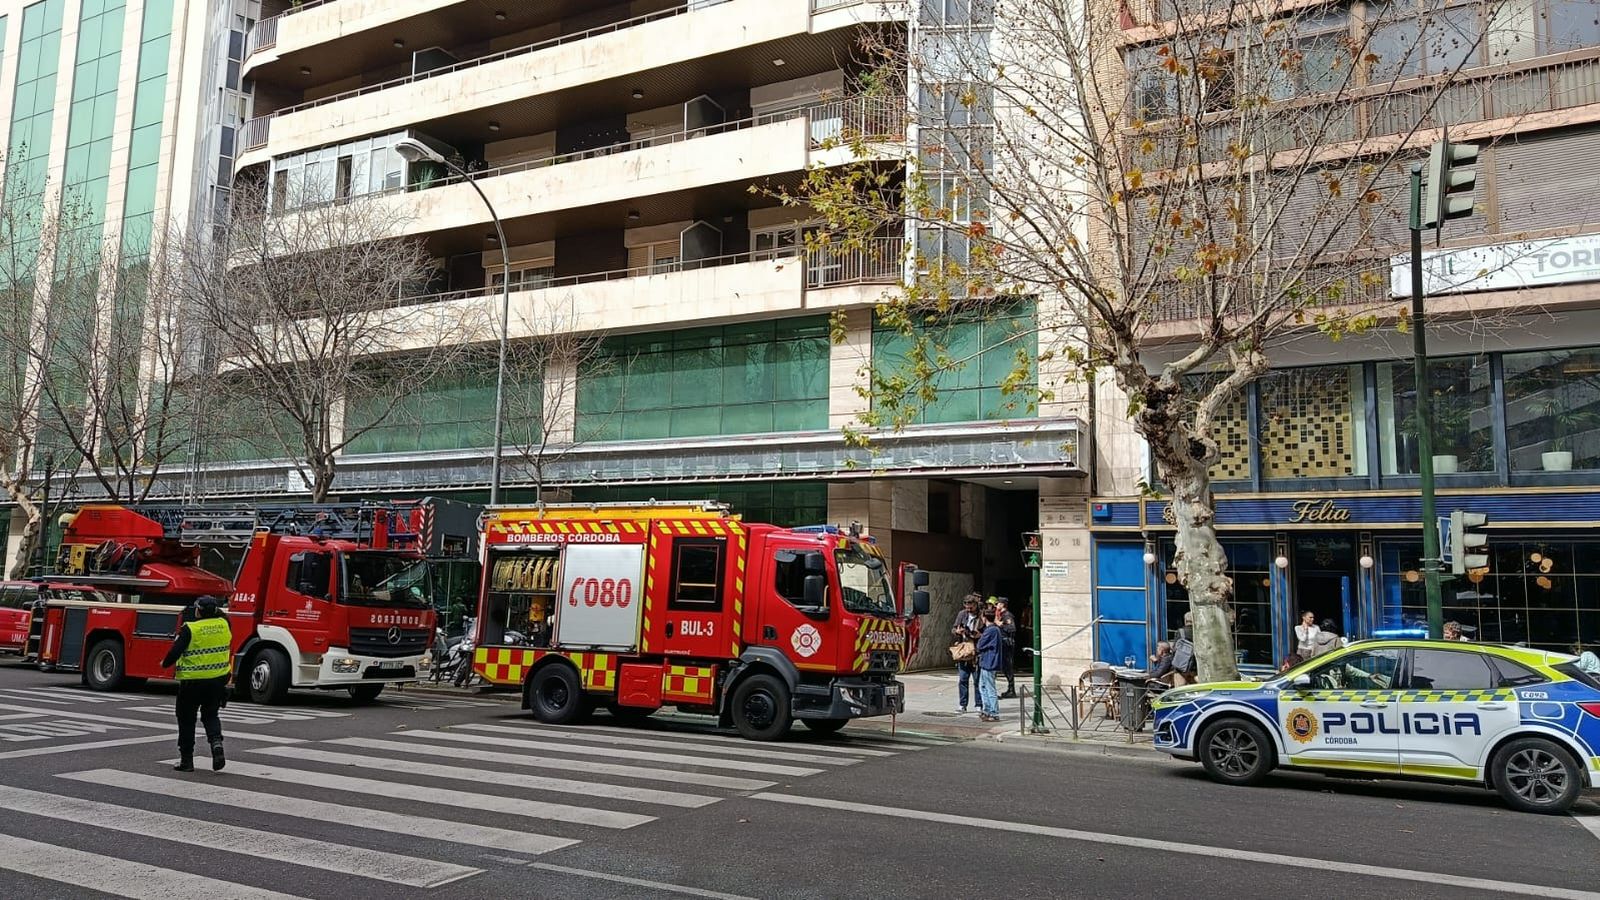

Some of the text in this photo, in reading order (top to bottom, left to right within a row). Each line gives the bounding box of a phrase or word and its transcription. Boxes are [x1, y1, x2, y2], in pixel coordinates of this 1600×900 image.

[1288, 499, 1350, 522] Felia
[507, 533, 565, 543] BOMBEROS
[1049, 537, 1060, 547] 20
[234, 593, 256, 602] AEA-2
[584, 577, 632, 608] 080
[680, 620, 714, 636] BUL-3
